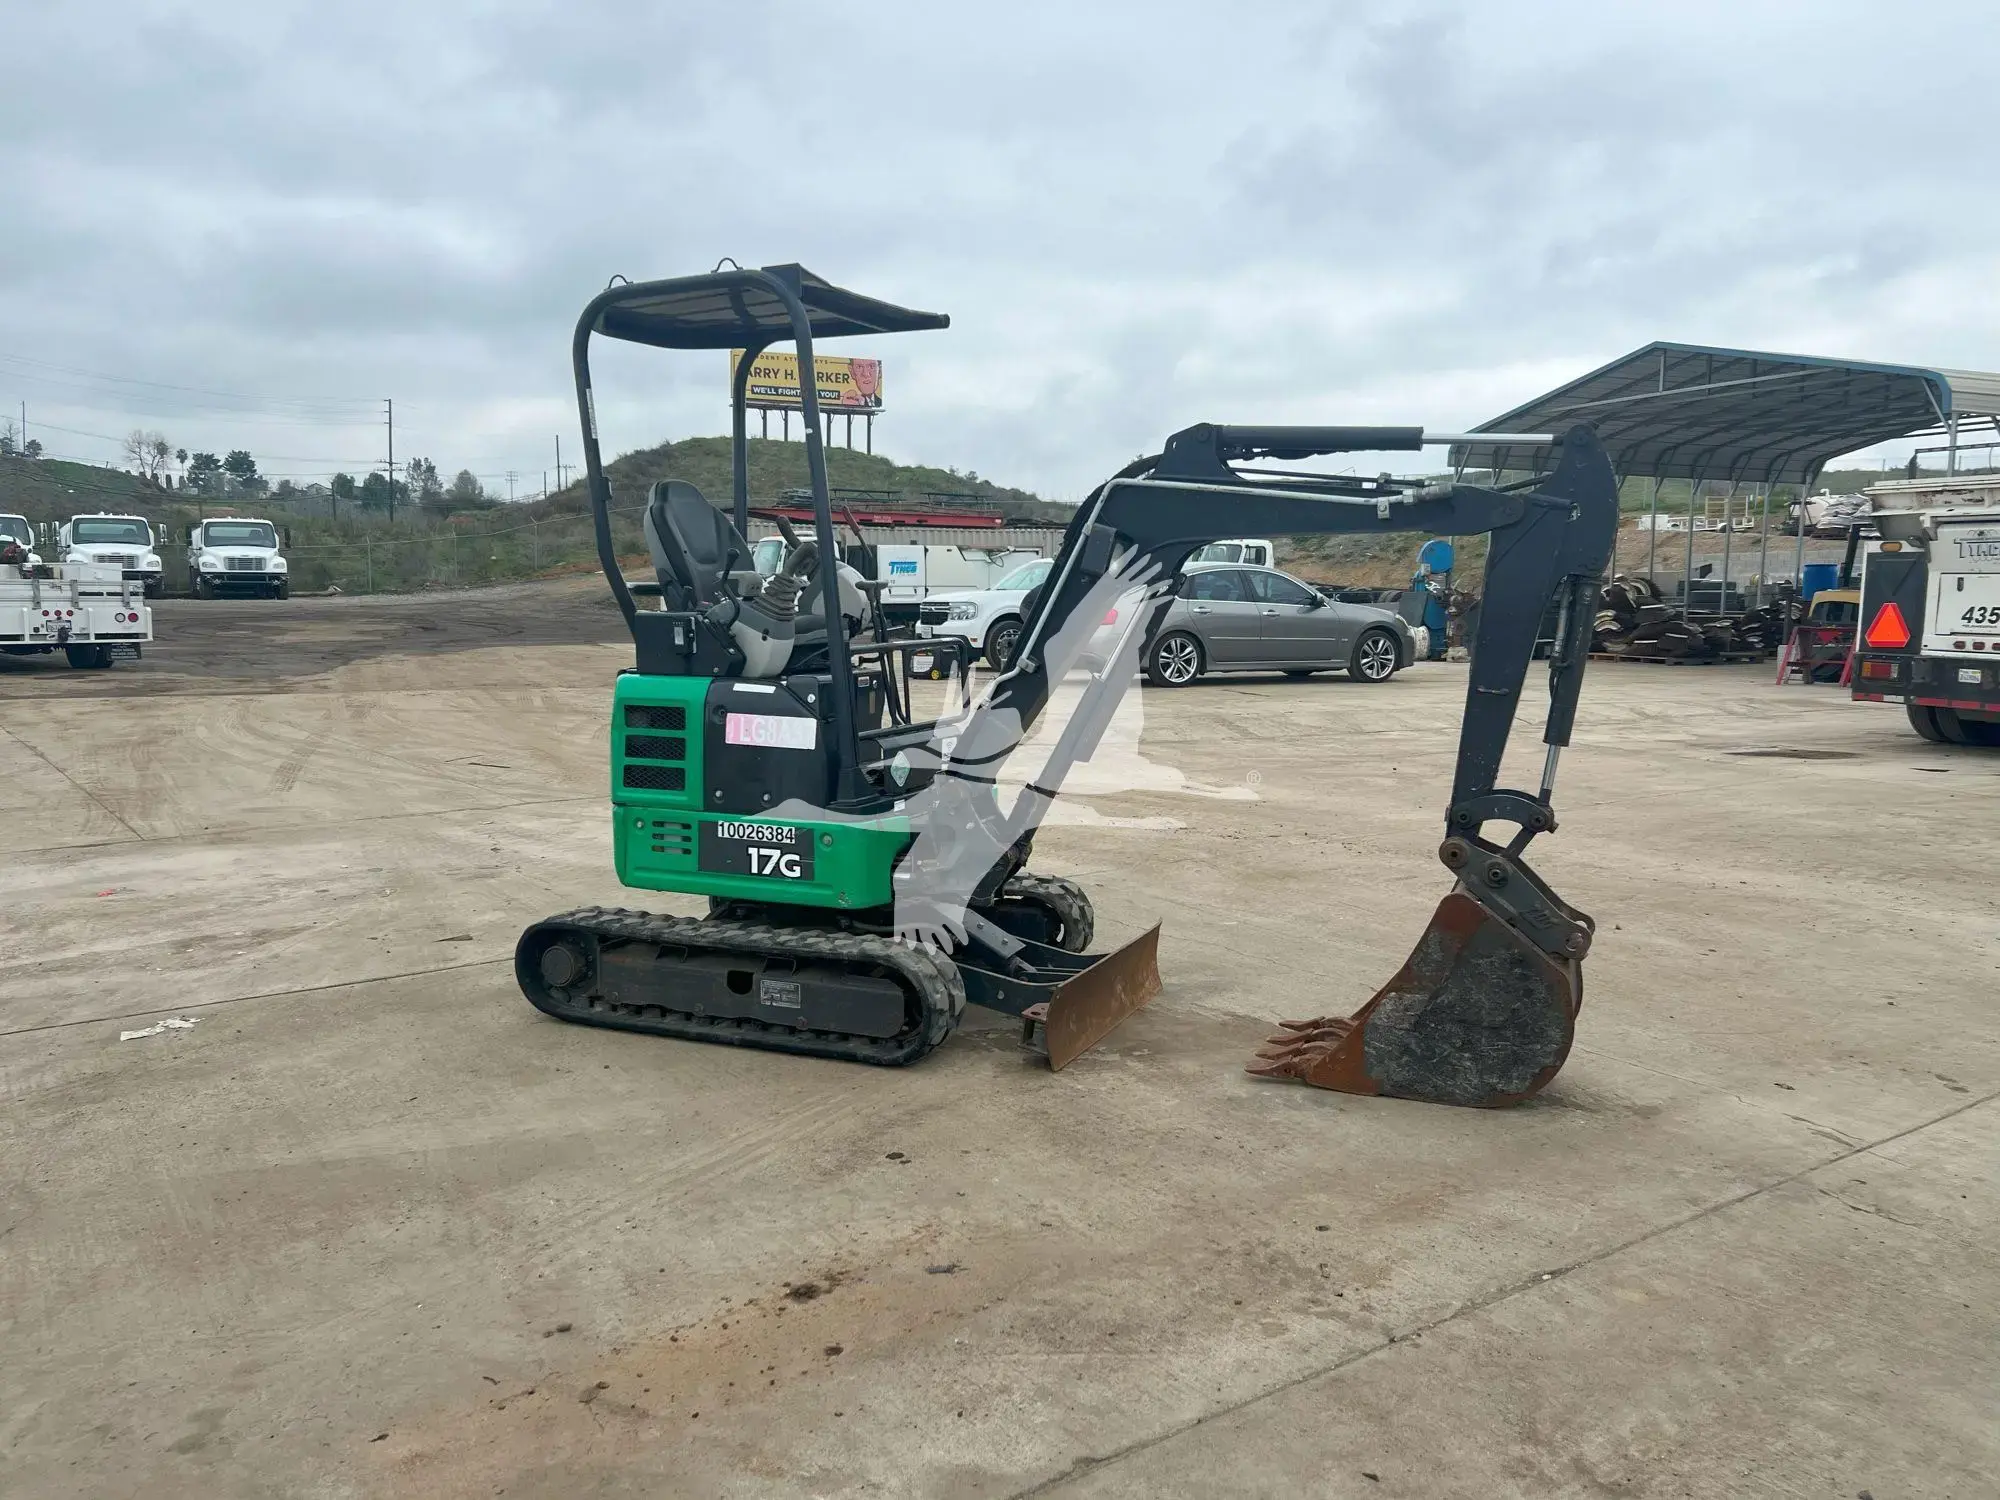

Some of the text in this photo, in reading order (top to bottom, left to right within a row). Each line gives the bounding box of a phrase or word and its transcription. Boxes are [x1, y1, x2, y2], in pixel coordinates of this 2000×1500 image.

[750, 367, 850, 384] ARRY H. RKER
[753, 386, 776, 394] WE'LL
[778, 388, 801, 396] FIGHT
[820, 391, 839, 399] YOU!
[718, 821, 795, 843] 10026384
[748, 847, 801, 878] 17G
